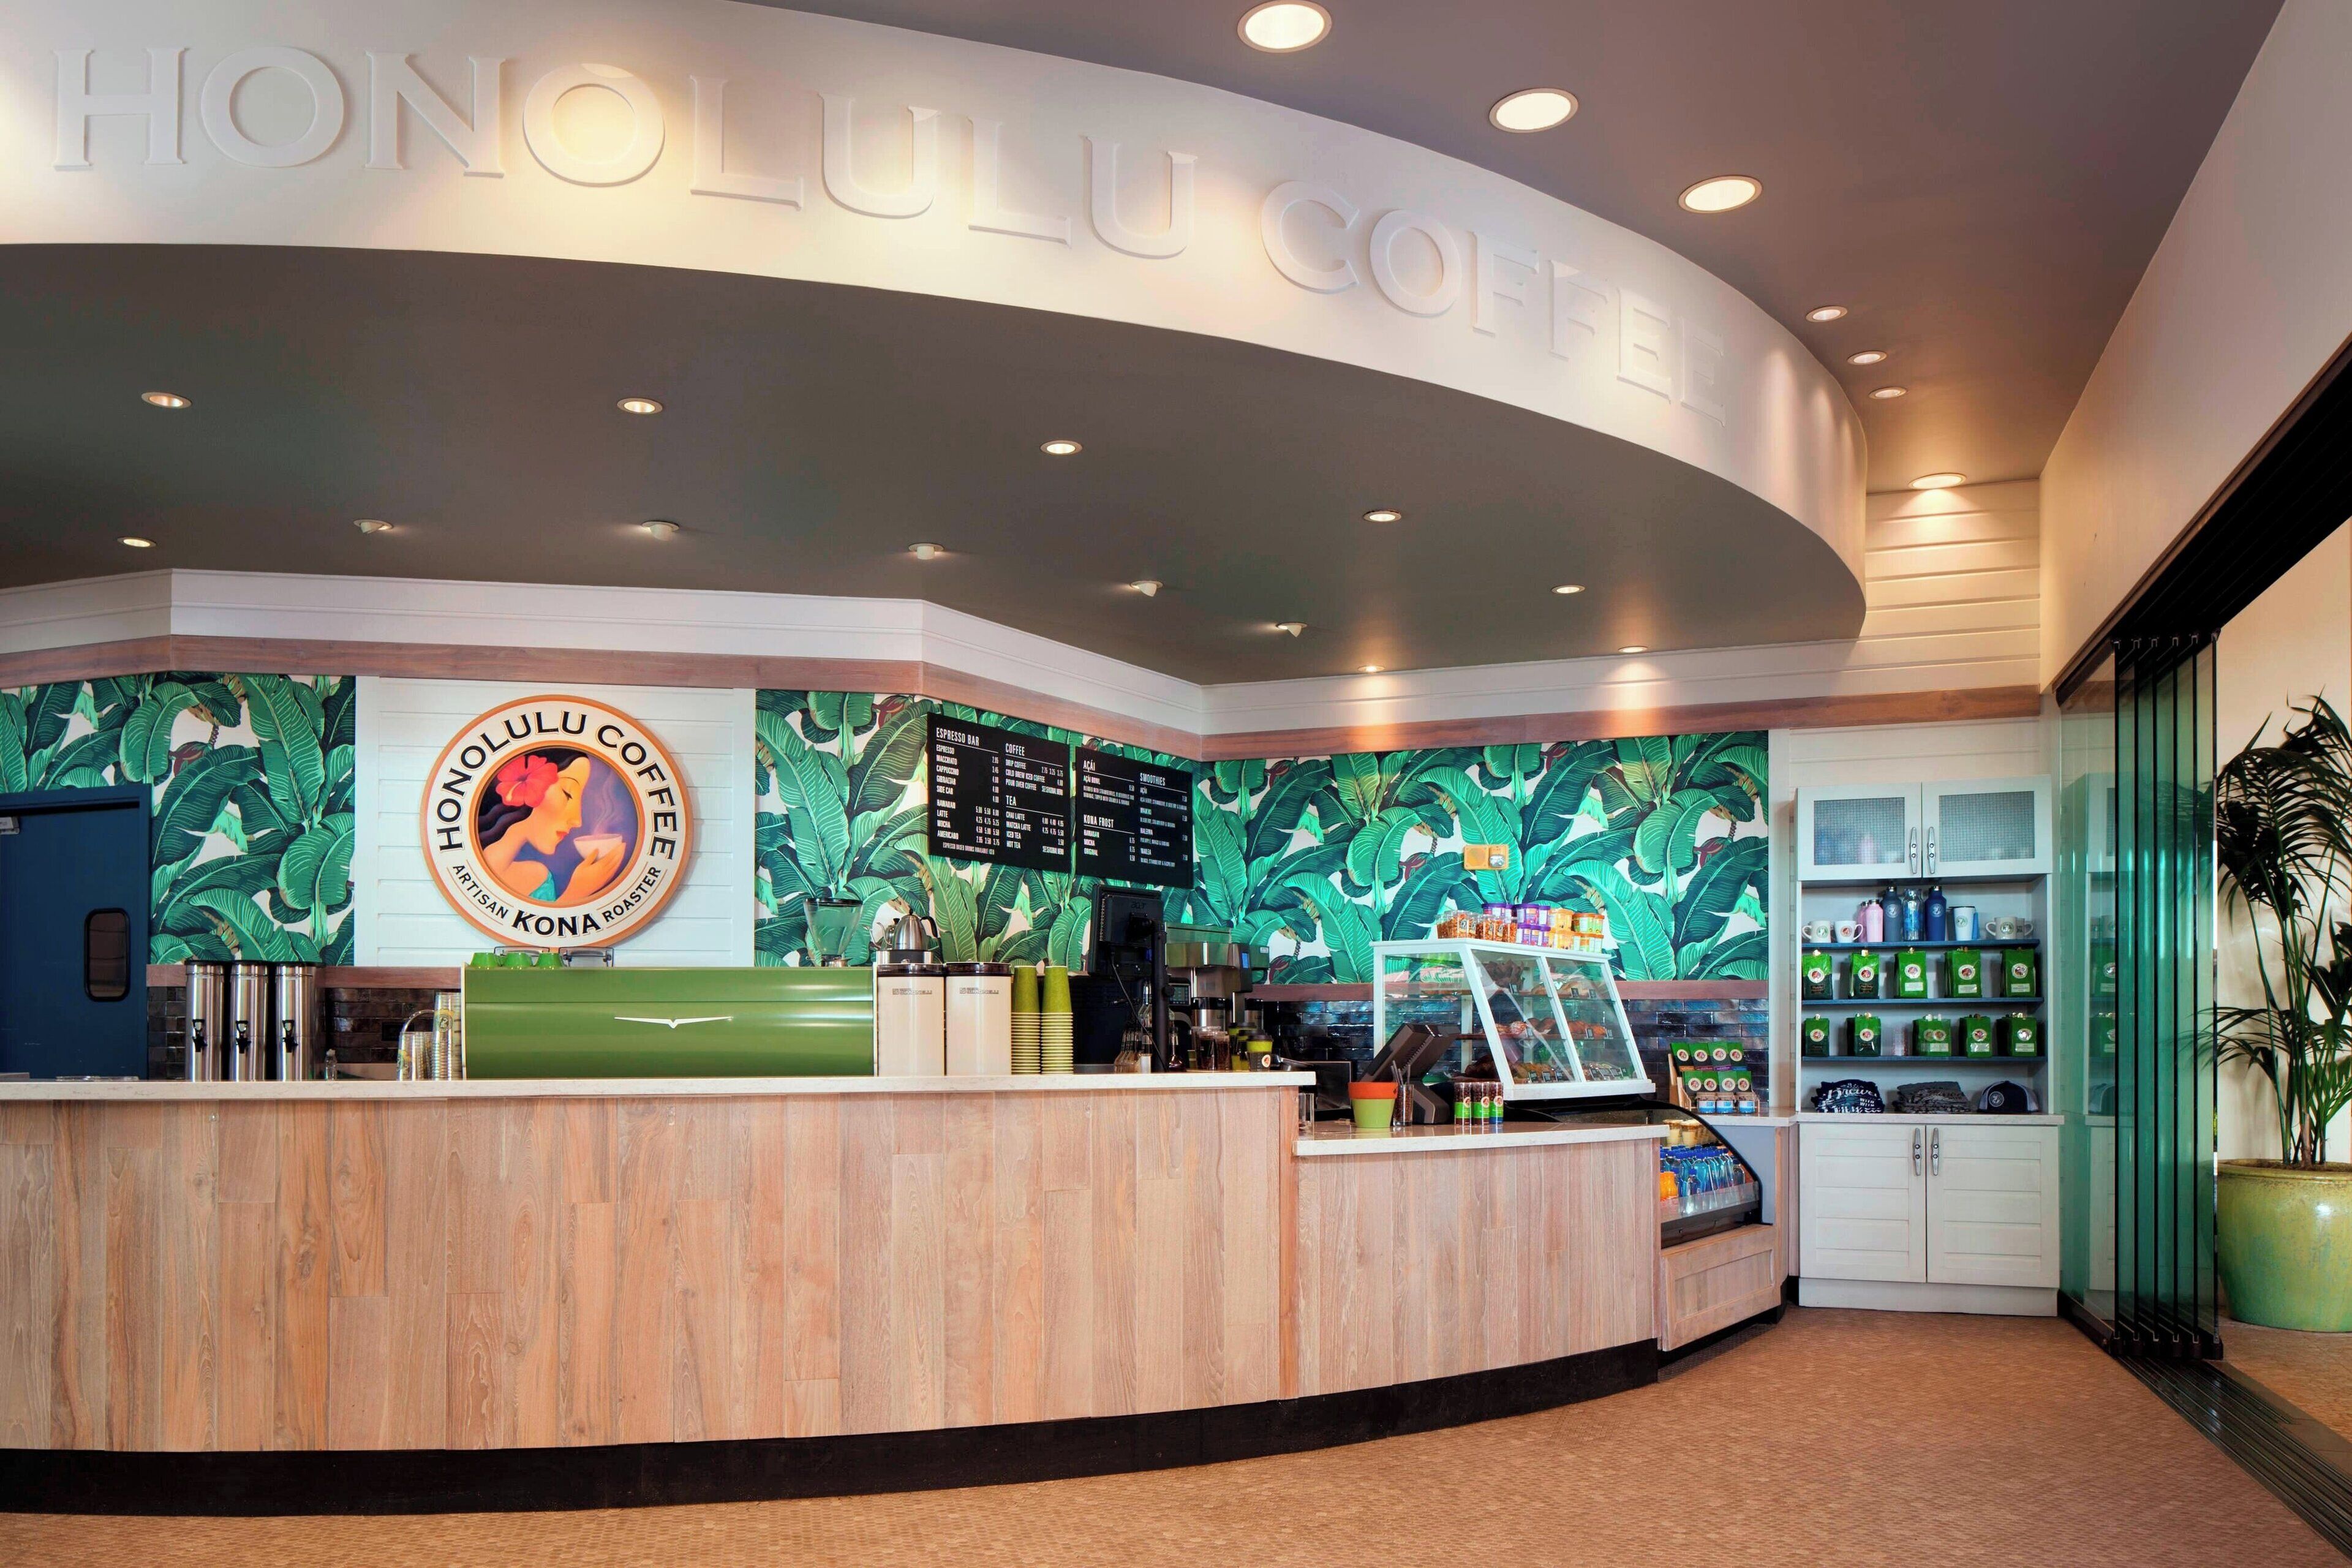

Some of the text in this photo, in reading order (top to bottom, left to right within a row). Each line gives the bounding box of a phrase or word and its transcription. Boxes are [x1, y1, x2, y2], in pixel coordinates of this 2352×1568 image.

[51, 45, 1726, 427] HONOLULU COFFEE
[936, 727, 979, 746] ESPRESSO BAR
[936, 744, 954, 755] ESPRESSO
[1005, 743, 1025, 756] COFFEE
[936, 755, 957, 765] MACCHIATO
[1014, 761, 1027, 769] COFFEE
[936, 765, 959, 775] CAPPUCCINO
[937, 775, 956, 785] GIBRALTAR
[1015, 770, 1025, 778] BREW
[1033, 774, 1045, 783] COFFEE
[1140, 772, 1165, 786] SMOOTHIES
[436, 710, 678, 860] HONOLULU COFFEE
[1025, 782, 1037, 791] COFFEE
[1006, 795, 1017, 806] TEA
[937, 809, 948, 818] LATTE
[937, 820, 951, 828] MOCHA
[1006, 821, 1020, 829] MATCHA
[1084, 814, 1114, 828] KONA FROST
[937, 830, 959, 840] AMERICANO
[453, 863, 662, 937] ARTISAN KONA ROASTER
